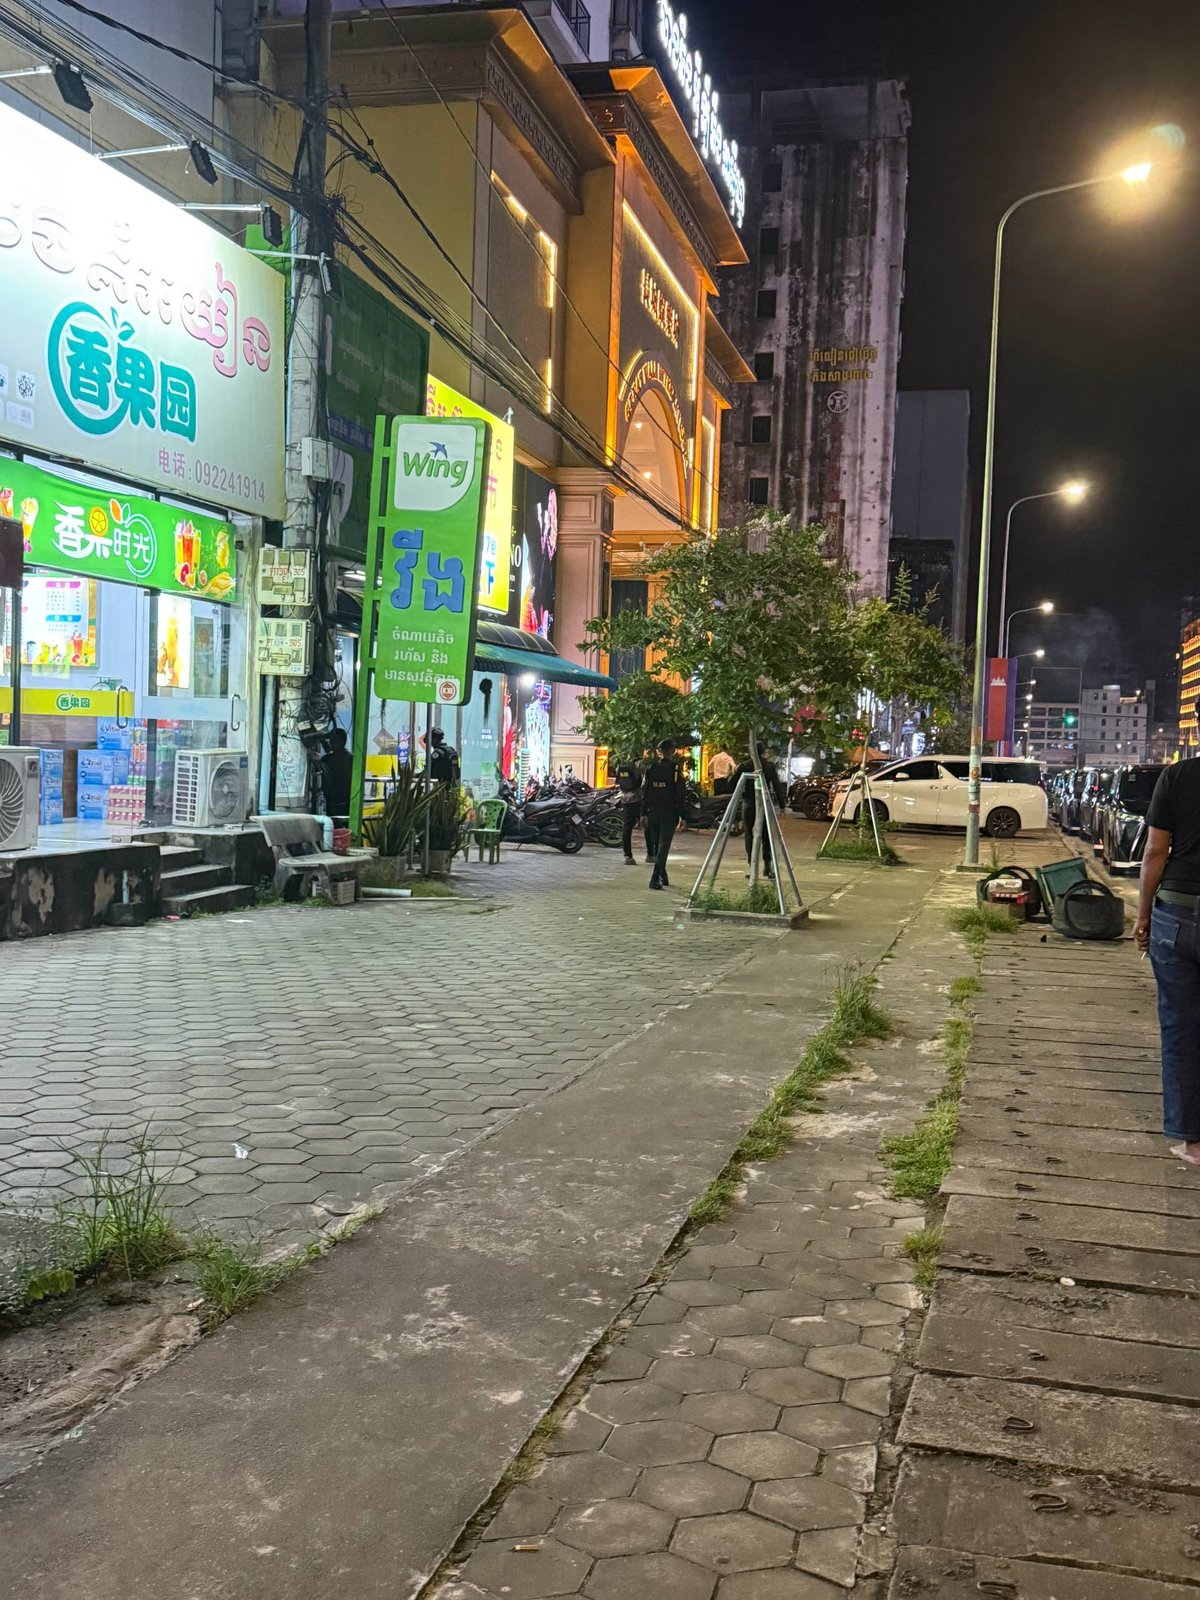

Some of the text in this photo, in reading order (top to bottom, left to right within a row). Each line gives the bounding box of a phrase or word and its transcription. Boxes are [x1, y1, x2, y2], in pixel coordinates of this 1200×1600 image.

[62, 312, 196, 443] 香果园
[403, 451, 468, 488] Wing
